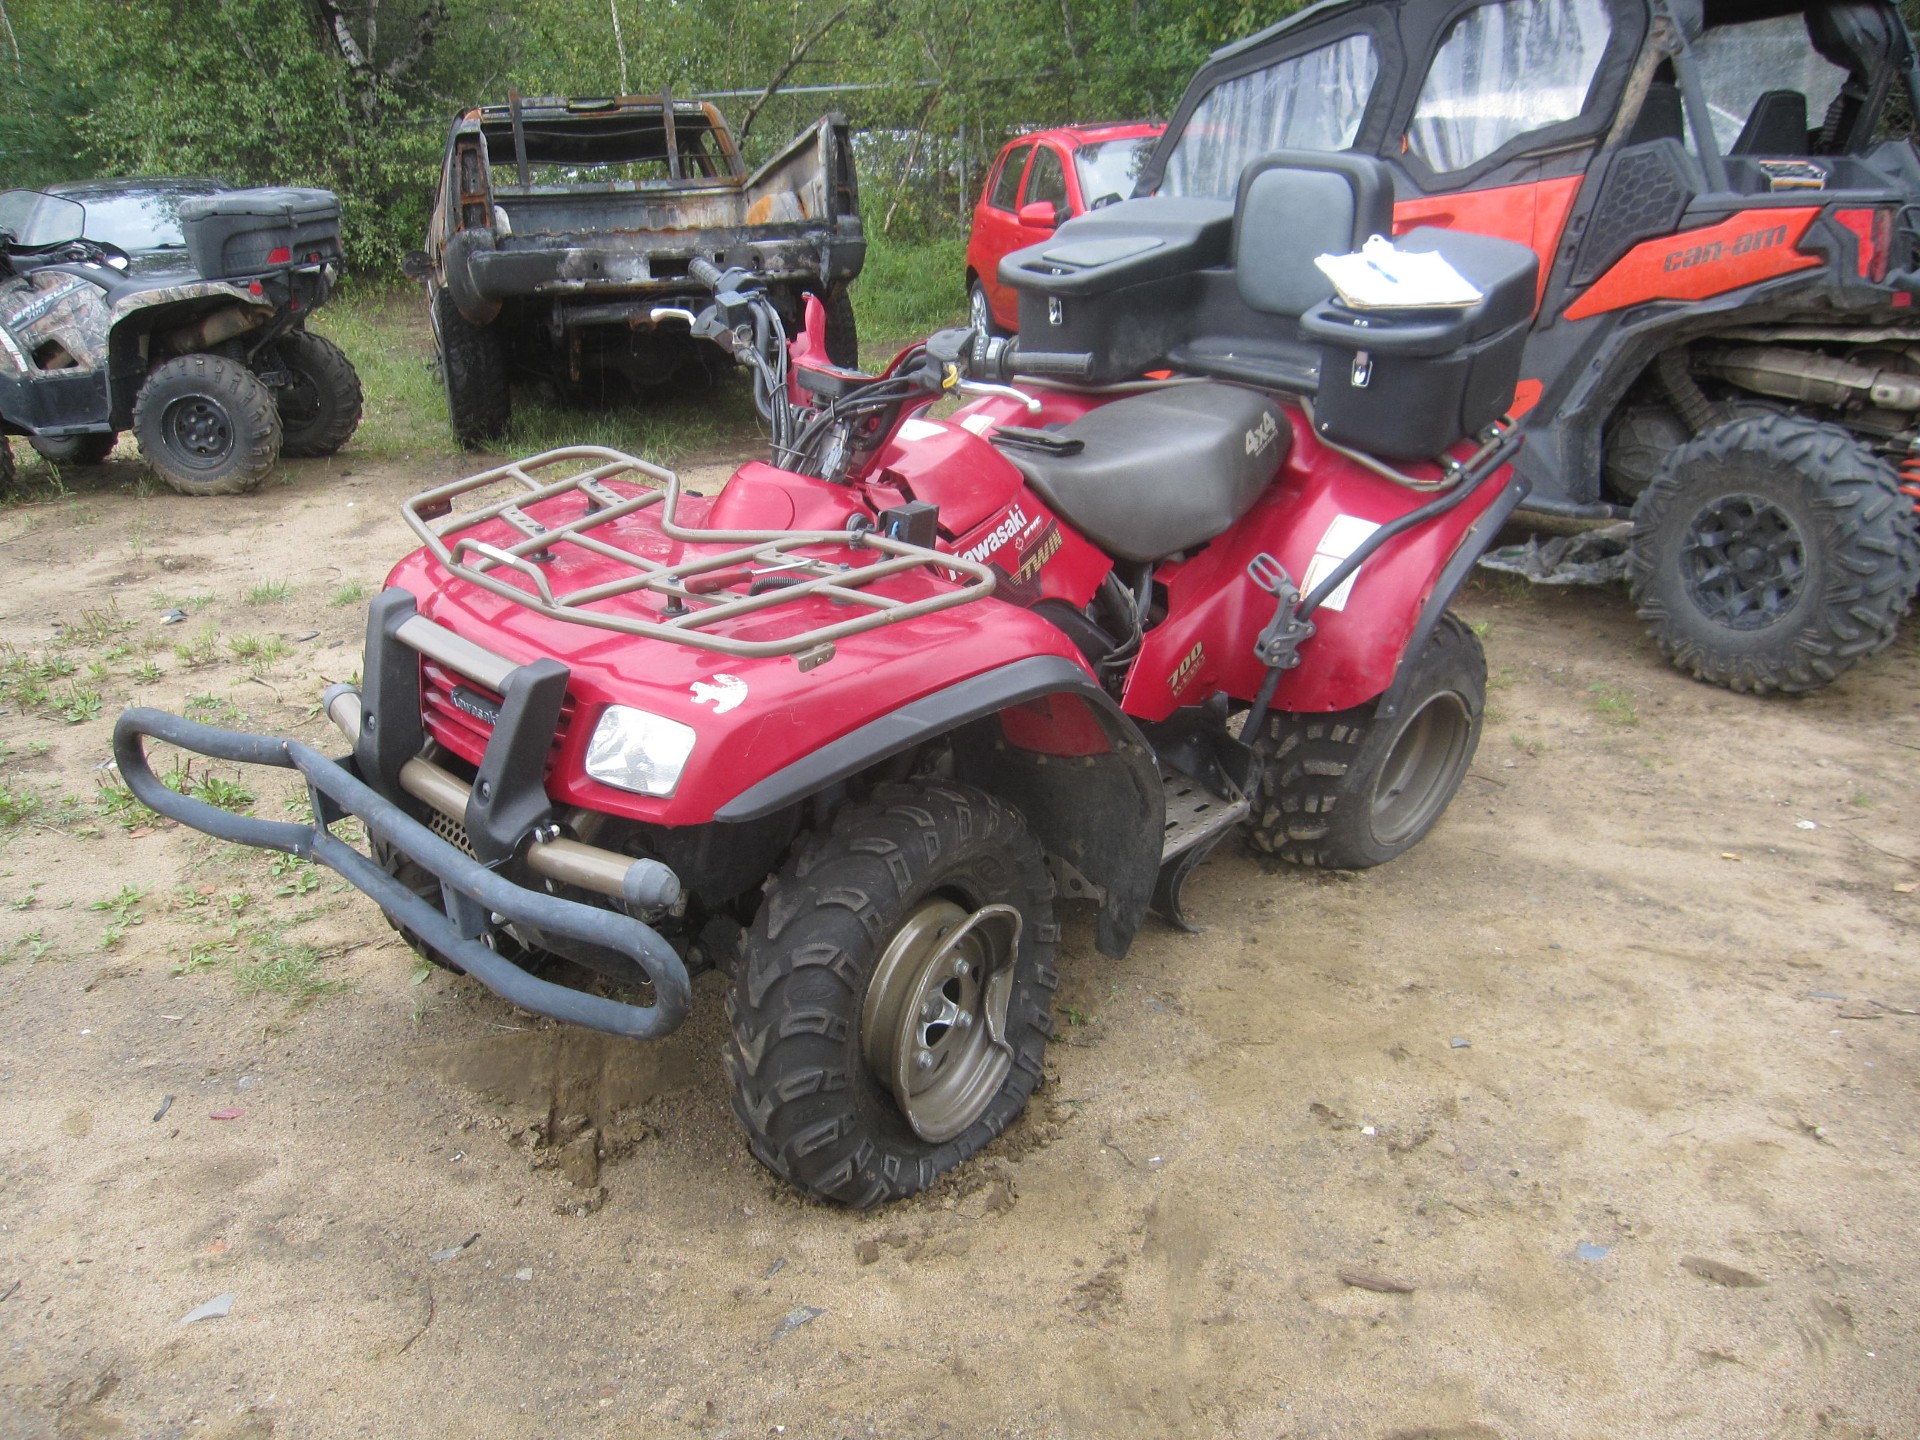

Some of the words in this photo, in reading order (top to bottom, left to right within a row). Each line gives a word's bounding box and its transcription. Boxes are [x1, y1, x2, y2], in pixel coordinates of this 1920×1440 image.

[1663, 224, 1788, 272] can-am
[1246, 411, 1276, 455] 4x4
[1020, 528, 1062, 581] TWIN
[1167, 641, 1202, 688] 700
[451, 690, 499, 725] Kawasak
